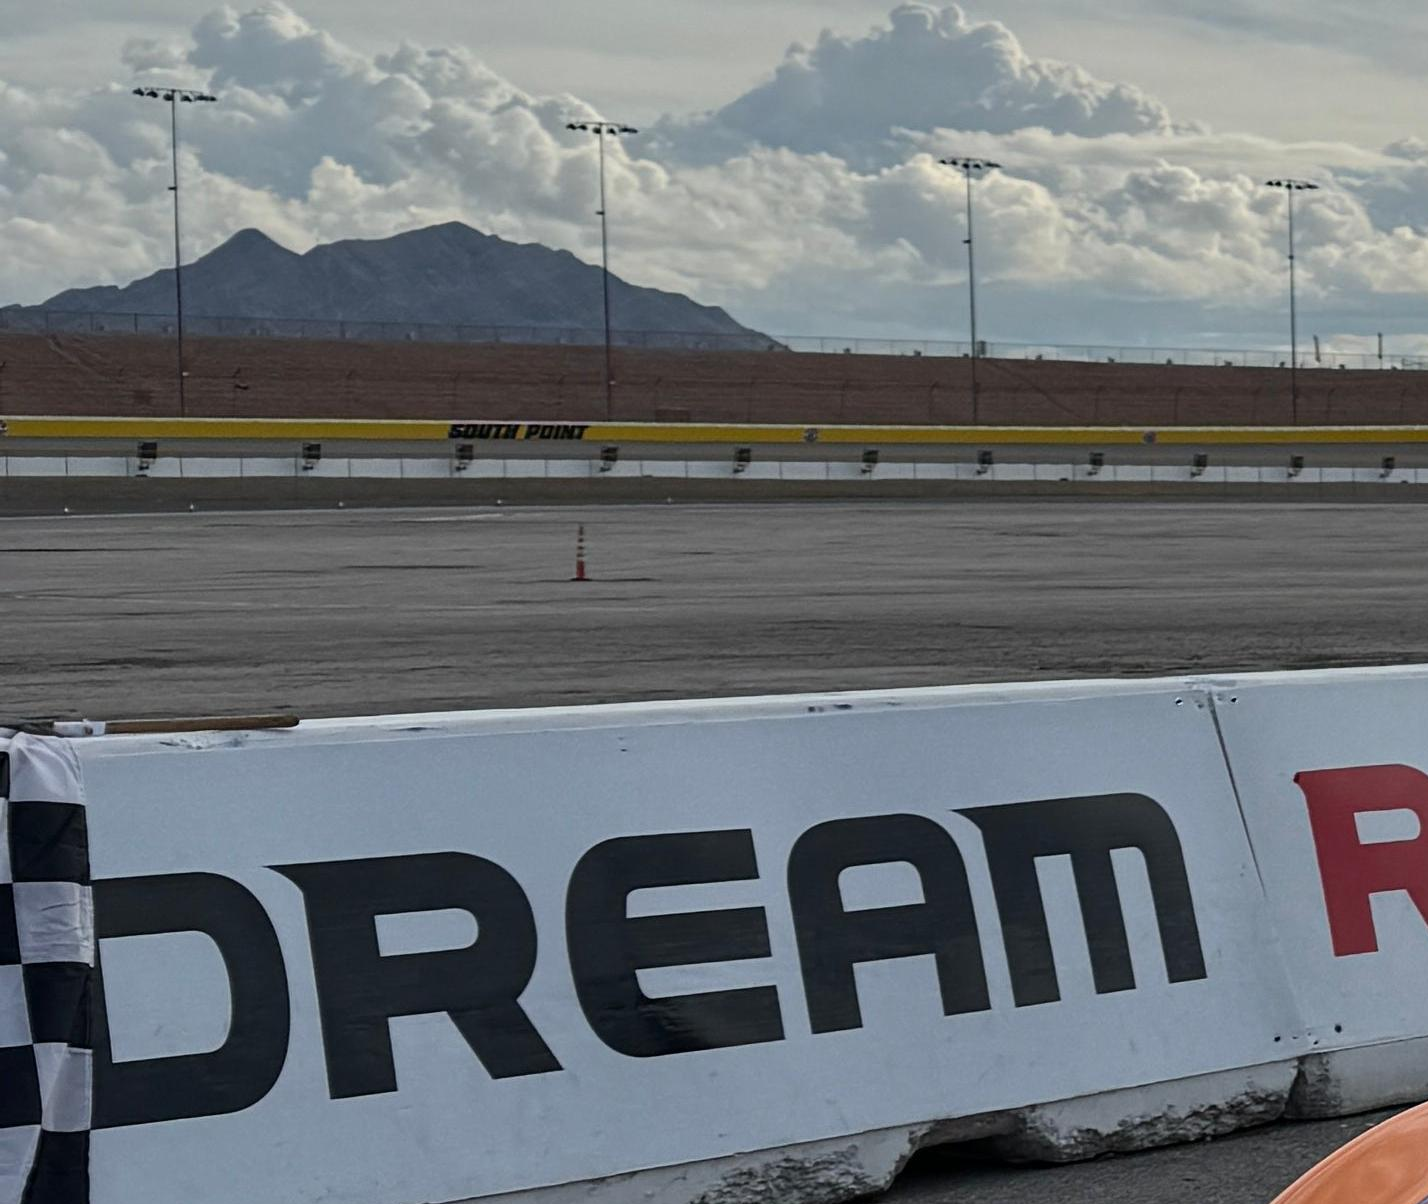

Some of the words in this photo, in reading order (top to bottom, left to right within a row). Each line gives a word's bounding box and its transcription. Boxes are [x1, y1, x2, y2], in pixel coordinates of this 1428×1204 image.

[448, 424, 521, 439] SOUTH
[523, 424, 591, 439] POINT
[90, 792, 1208, 1130] DREAM
